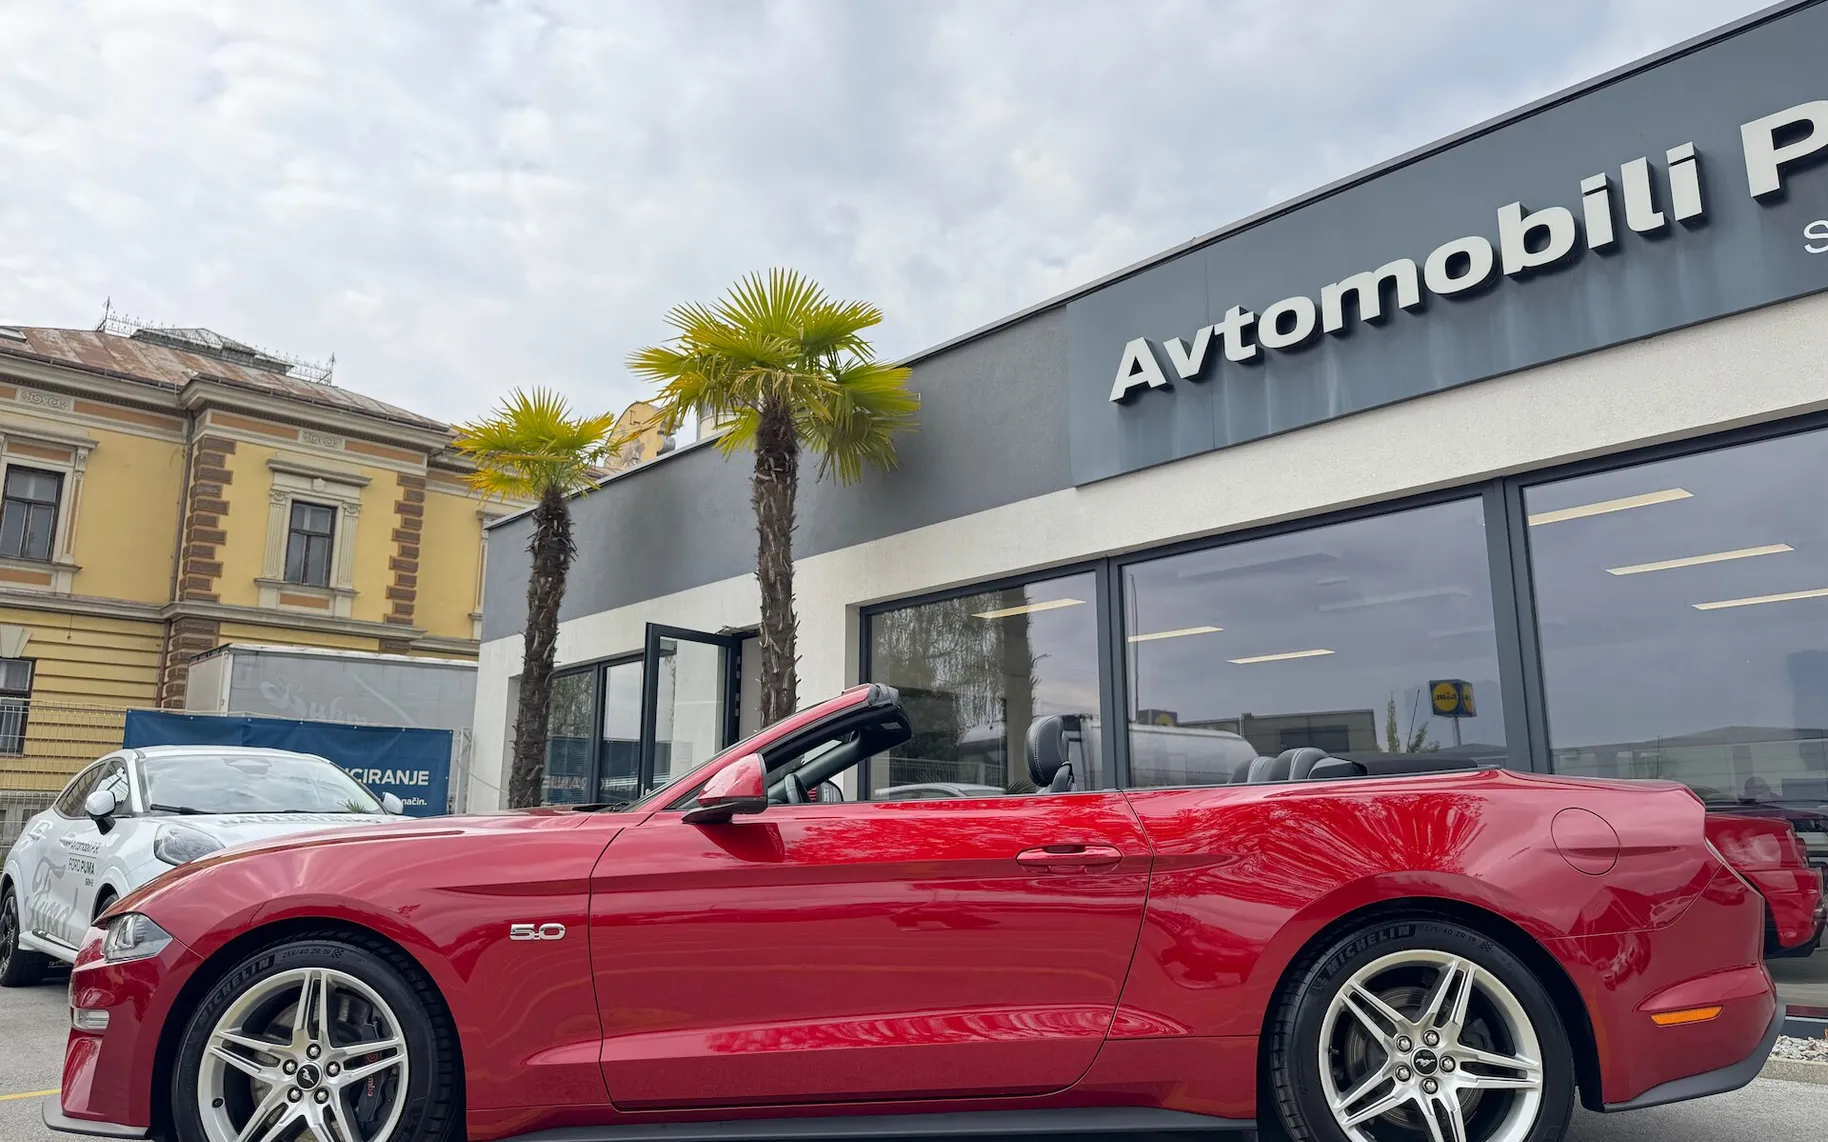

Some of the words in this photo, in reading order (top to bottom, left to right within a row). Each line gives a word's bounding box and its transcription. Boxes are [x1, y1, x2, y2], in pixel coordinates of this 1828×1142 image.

[1109, 142, 1704, 404] Avtomobili
[345, 768, 430, 786] CIRANJE
[68, 857, 81, 872] FORD
[81, 860, 95, 875] PUMA
[1326, 925, 1411, 975] MICHELIN
[197, 956, 271, 1026] MICHELIN
